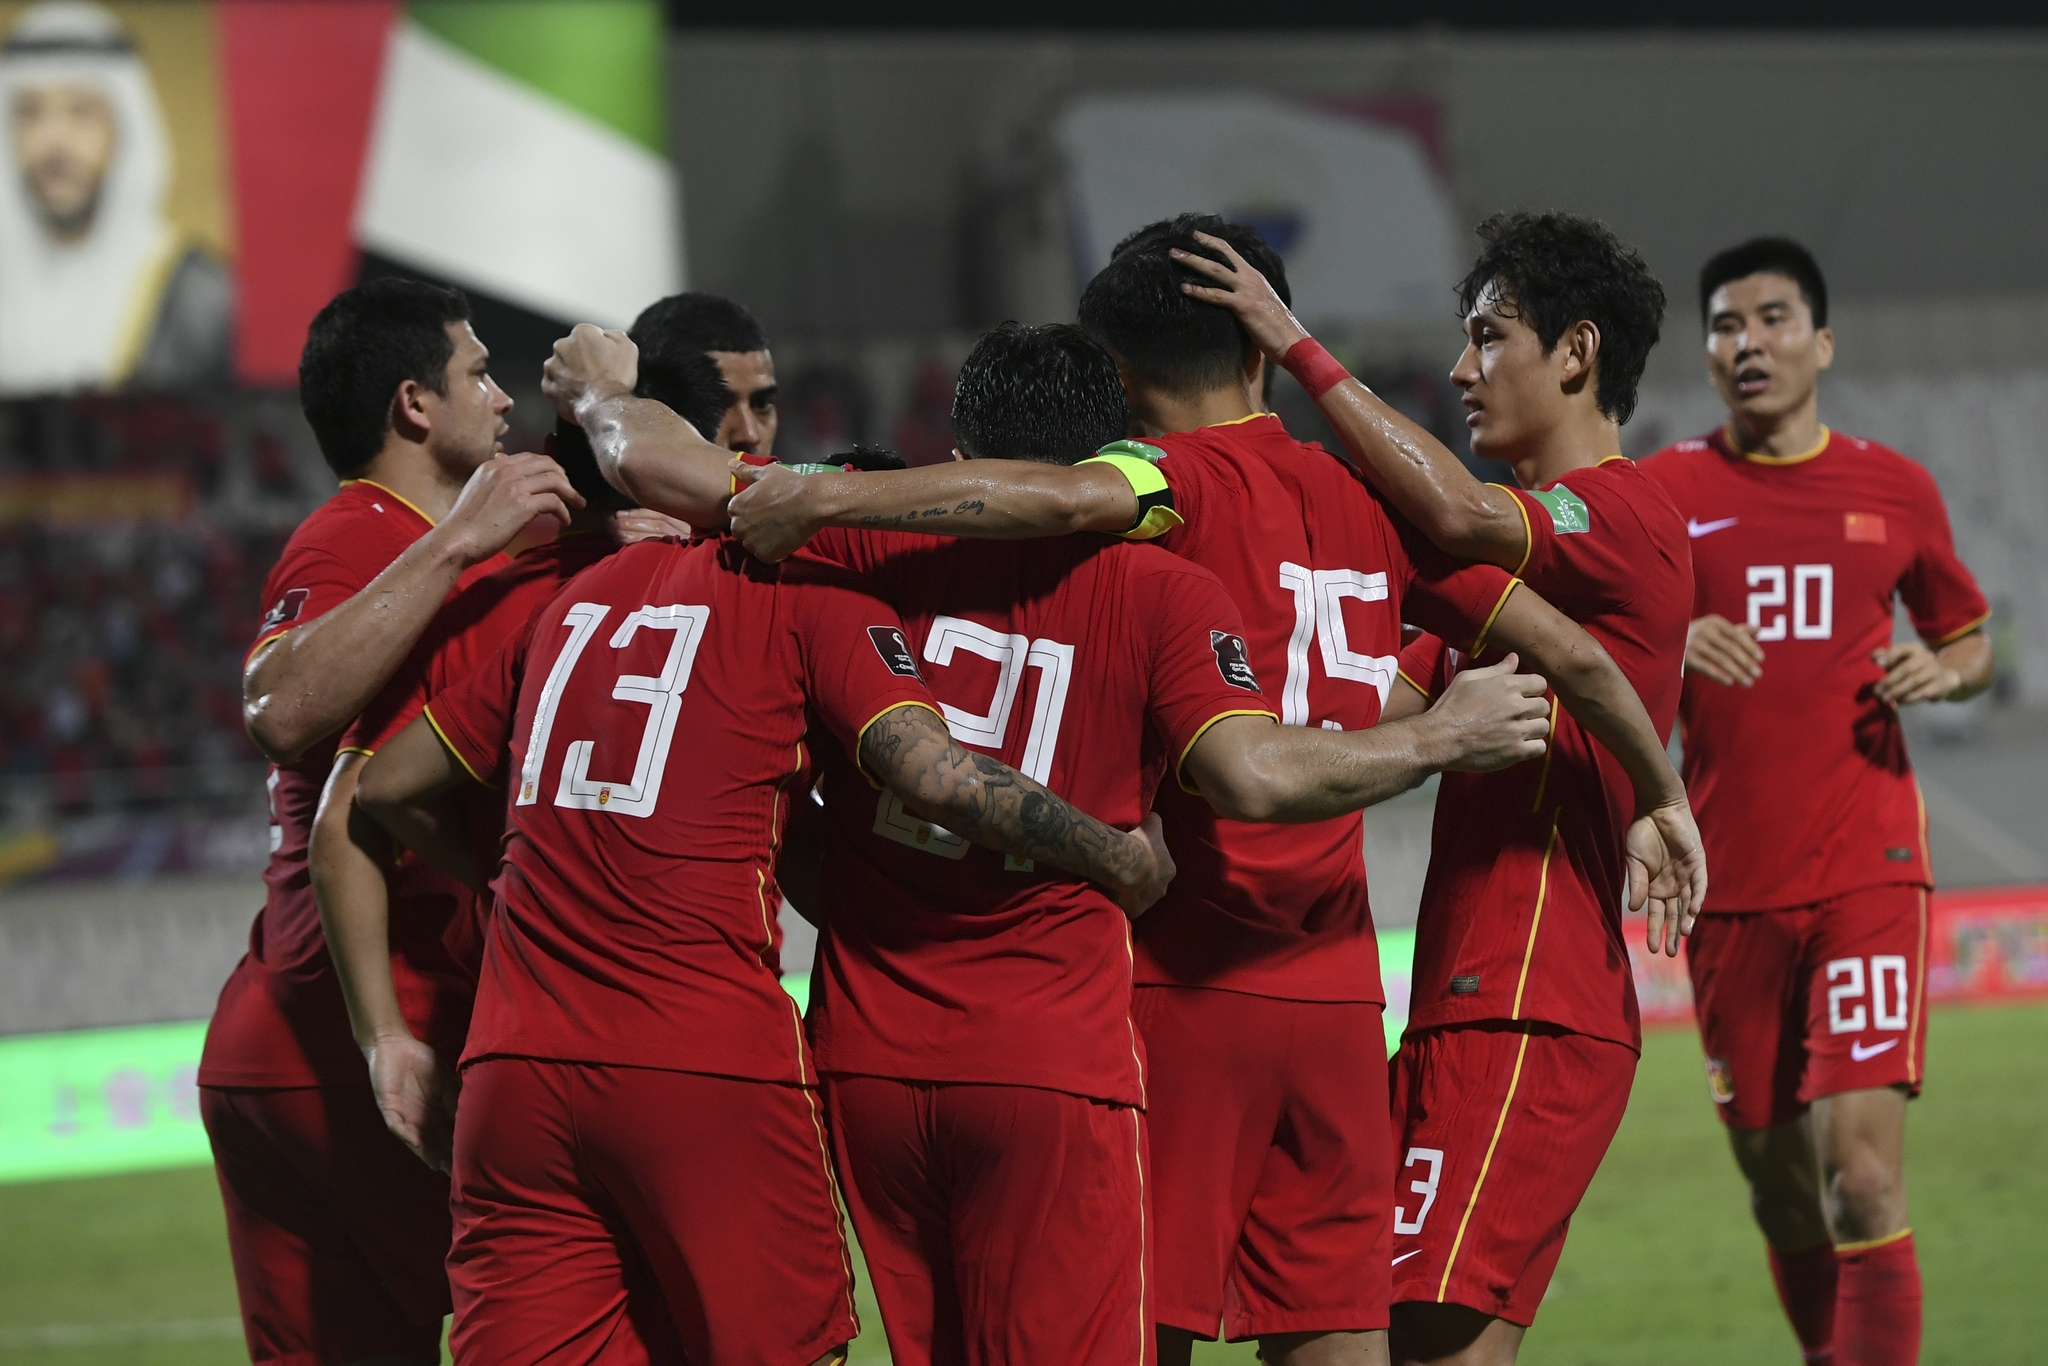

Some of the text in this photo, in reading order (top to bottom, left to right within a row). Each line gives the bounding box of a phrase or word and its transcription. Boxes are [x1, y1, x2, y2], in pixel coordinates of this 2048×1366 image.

[1280, 561, 1398, 731] 15
[1746, 564, 1833, 641] 20
[516, 602, 710, 818] 13
[873, 614, 1075, 872] 21
[1826, 955, 1908, 1035] 20
[1394, 1147, 1444, 1234] 3
